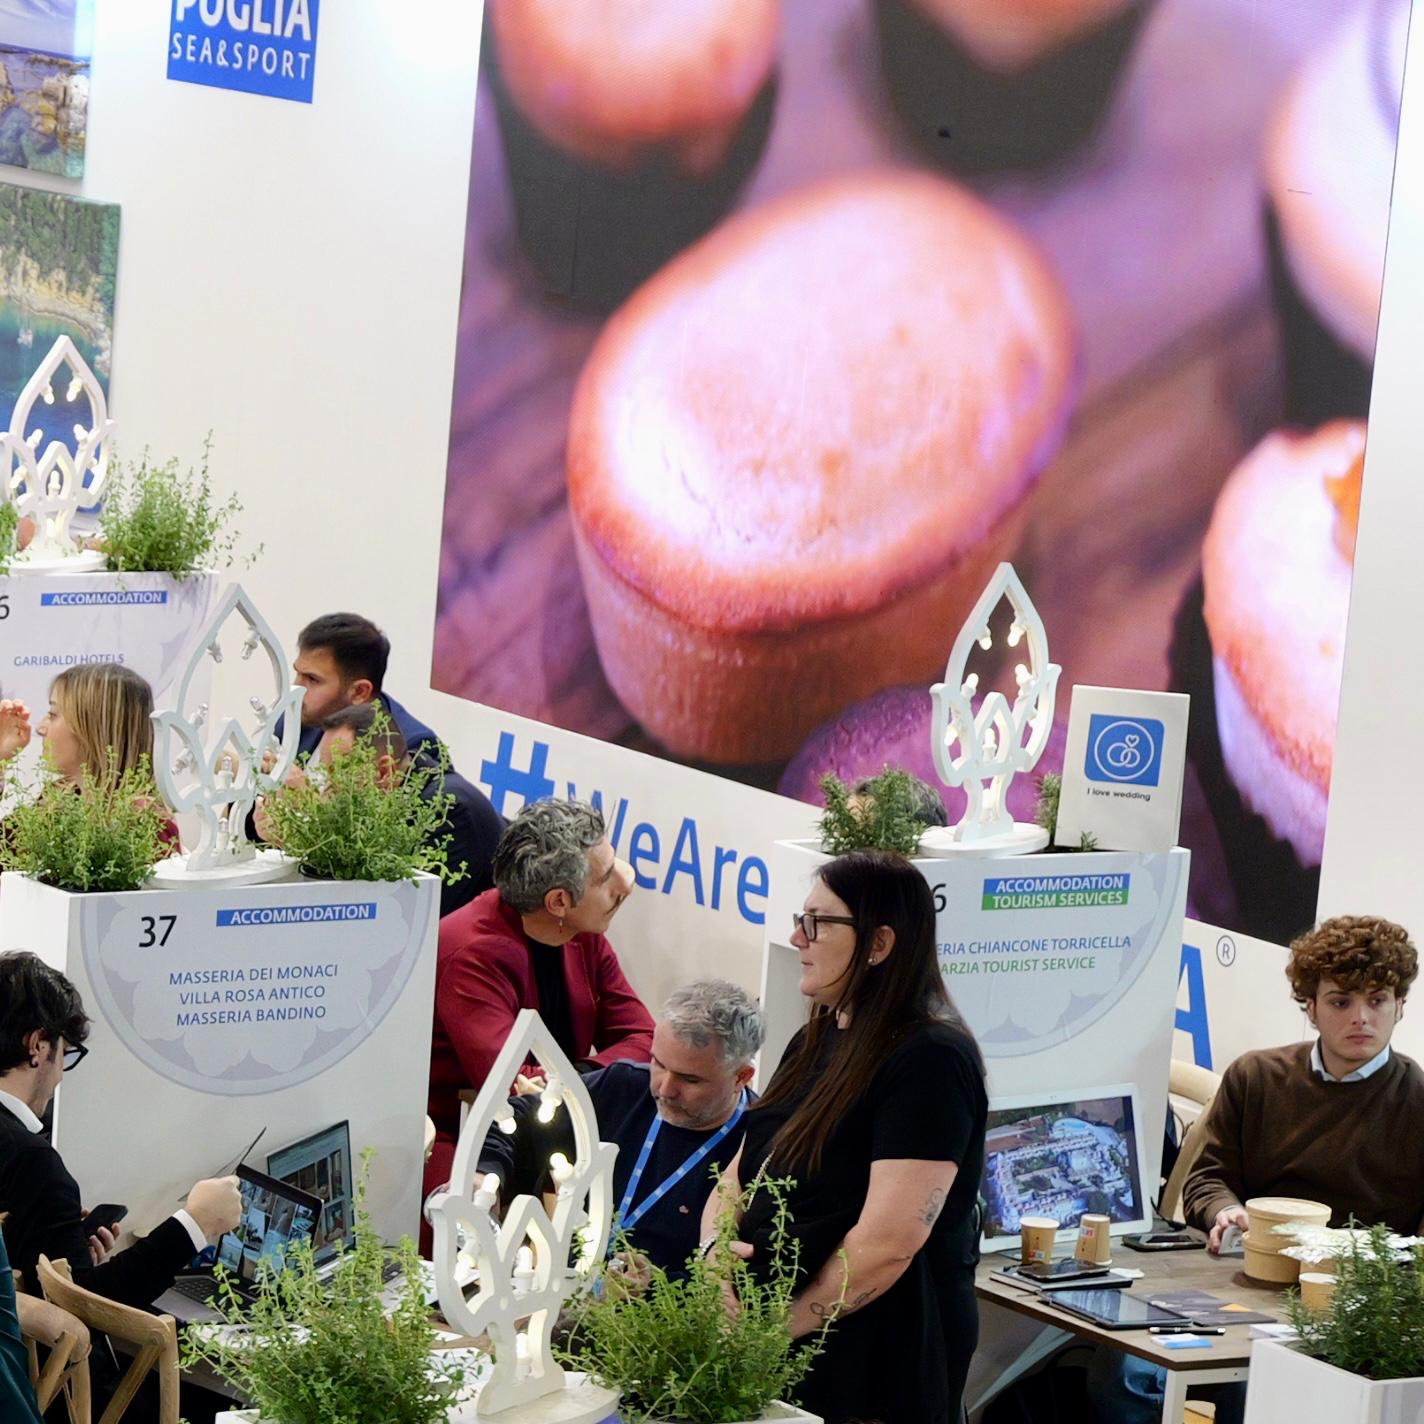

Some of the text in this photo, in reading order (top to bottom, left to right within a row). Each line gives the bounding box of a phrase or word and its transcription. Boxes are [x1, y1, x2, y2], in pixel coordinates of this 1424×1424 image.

[176, 0, 311, 41] PUGLIA
[171, 32, 311, 80] SEA&SPORT
[52, 592, 162, 605] ACCOMMODATION
[14, 653, 124, 667] GARIBALDI HOTELS
[1092, 788, 1110, 797] love
[1113, 789, 1152, 802] wedding
[995, 876, 1124, 893] ACCOMMODATION
[934, 883, 948, 913] 6
[992, 890, 1124, 909] TOURISM SERVICES
[230, 904, 371, 925] ACCOMMODATION
[138, 915, 178, 948] 37
[937, 935, 1132, 955] ERIA CHIANCONE TORRICELLA
[169, 964, 338, 985] MASSERIA DEI MONACI
[940, 956, 1096, 975] ARZIA TOURIST SERVICE
[179, 985, 326, 1005] VILLA ROSA ANTICO
[176, 1006, 326, 1026] MASSERIA BANDINO
